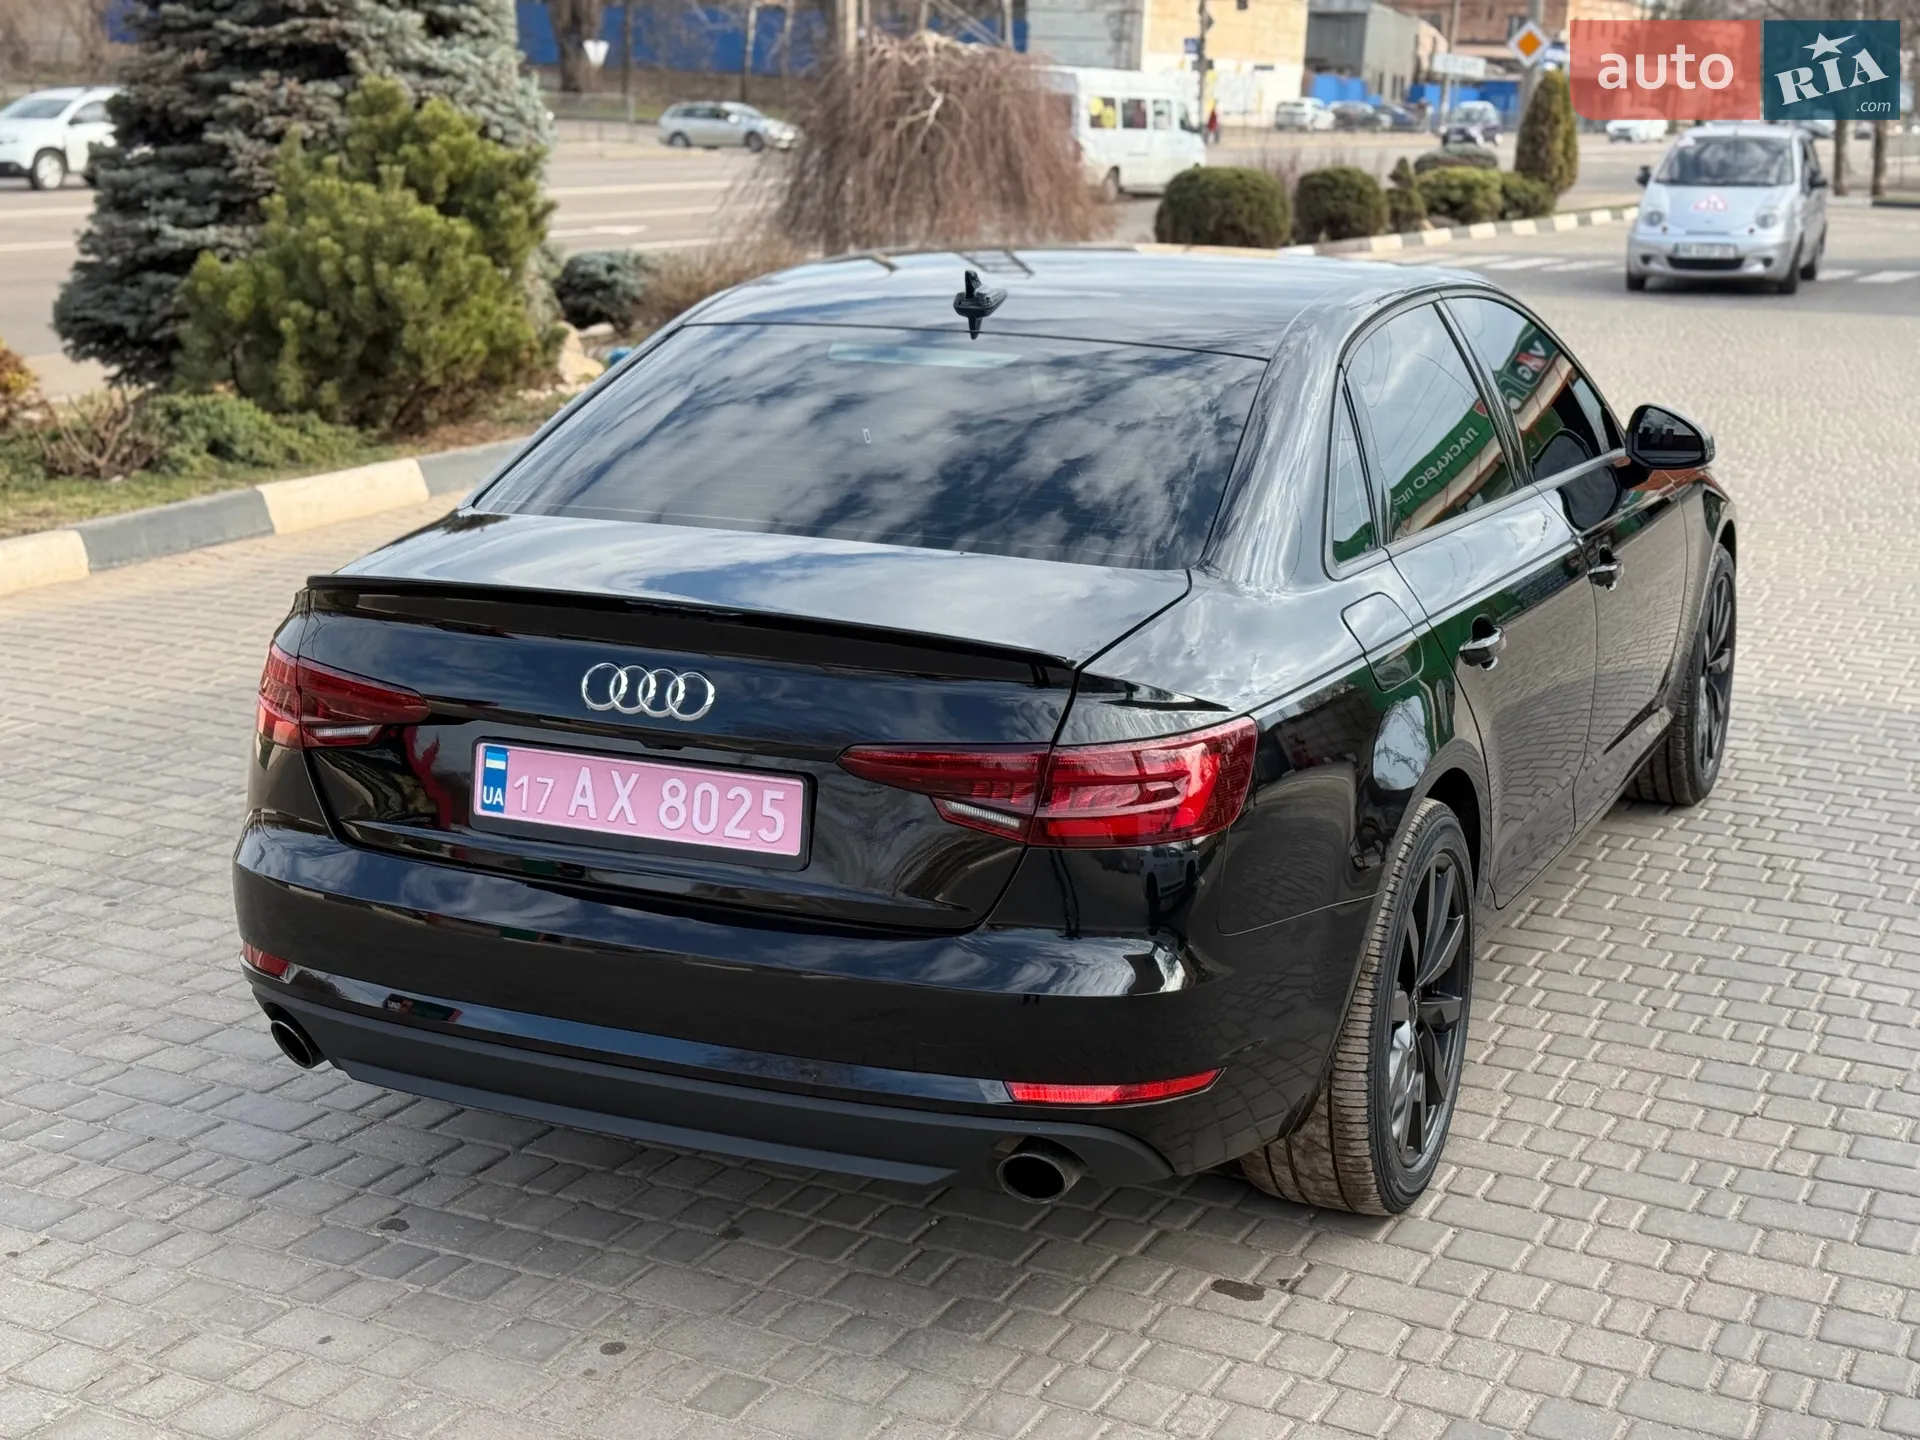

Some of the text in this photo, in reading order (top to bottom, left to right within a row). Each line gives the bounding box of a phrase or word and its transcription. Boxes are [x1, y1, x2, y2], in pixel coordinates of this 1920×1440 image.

[483, 766, 787, 844] UA 17 AX 8025
